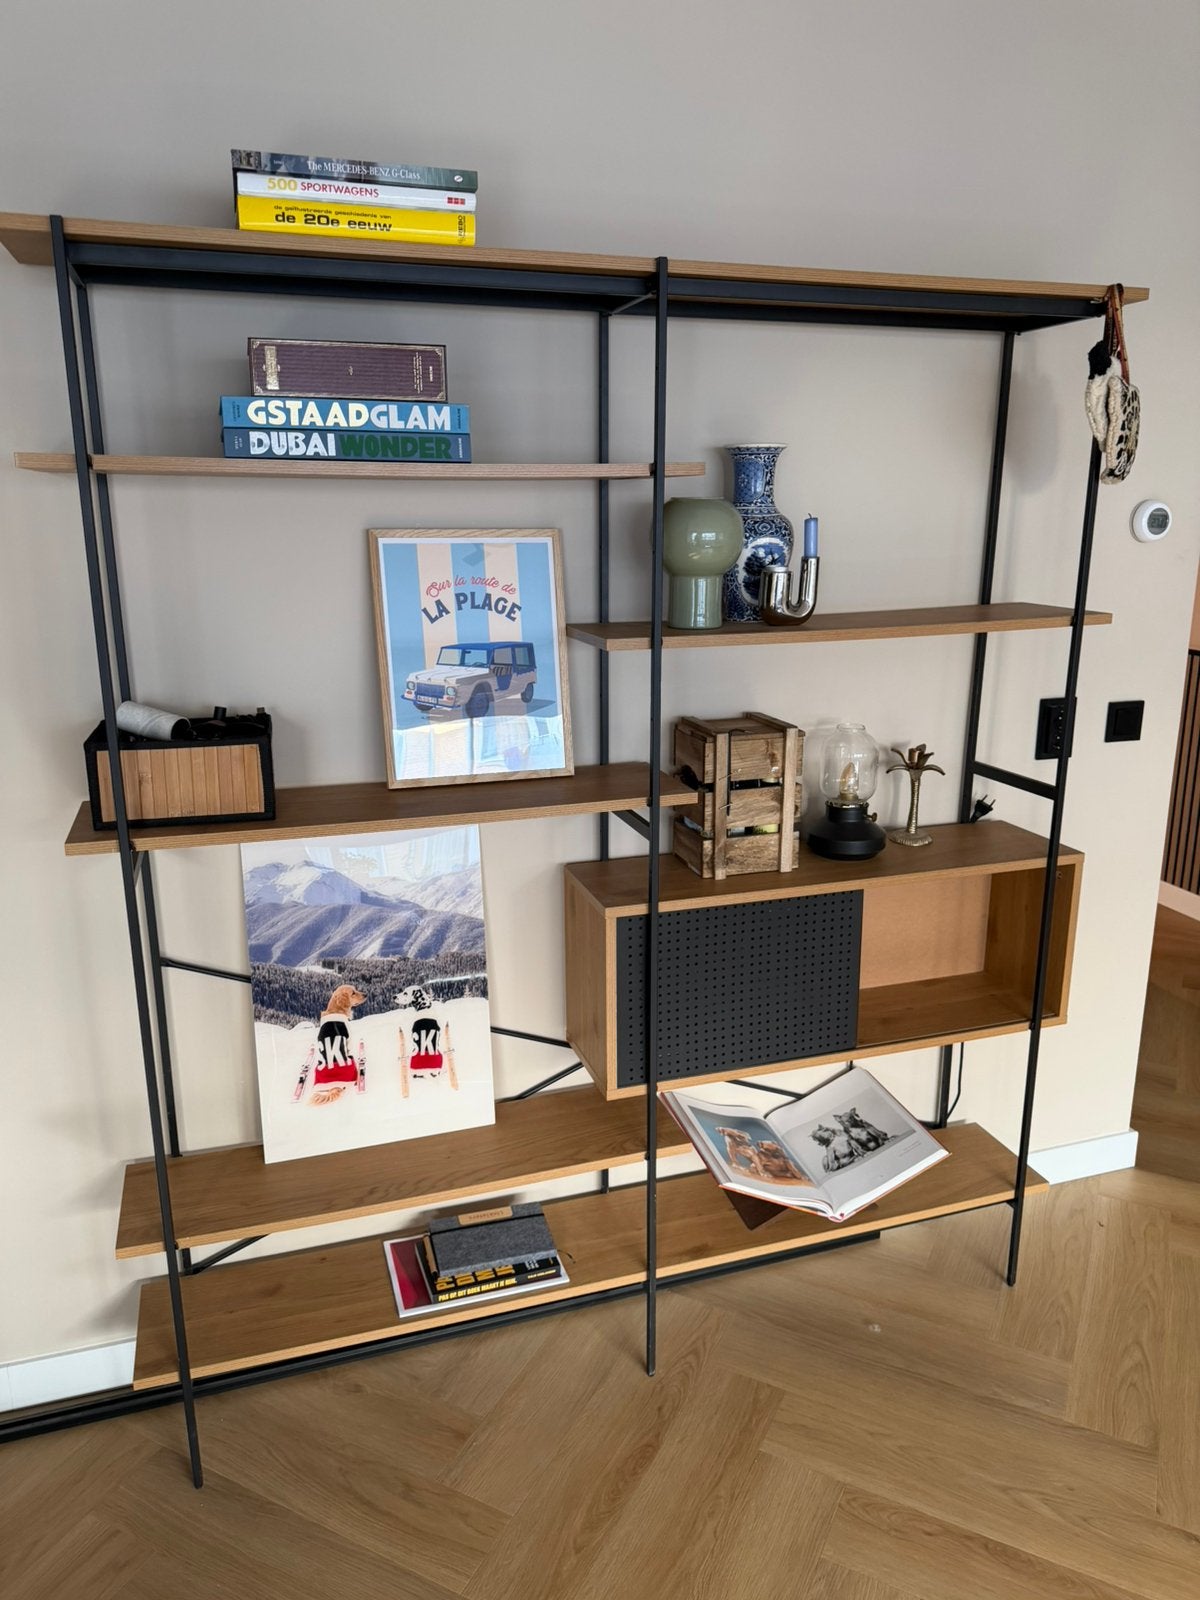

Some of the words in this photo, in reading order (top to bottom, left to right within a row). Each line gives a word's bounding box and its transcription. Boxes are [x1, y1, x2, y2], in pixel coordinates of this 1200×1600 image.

[307, 160, 322, 171] The
[323, 162, 390, 177] MERCEDES-BENZ
[391, 168, 421, 180] G-Class
[267, 177, 297, 191] 500
[300, 181, 379, 198] SPORTWAGENS
[275, 212, 296, 224] de
[303, 213, 340, 226] 20e
[347, 220, 393, 232] eeuw
[249, 431, 337, 456] DUBAI
[339, 434, 453, 459] WONDER
[426, 580, 452, 598] Sur
[454, 575, 466, 586] la
[470, 576, 499, 588] route
[501, 583, 516, 594] de
[421, 599, 451, 624] LA
[455, 591, 522, 622] PLAGE
